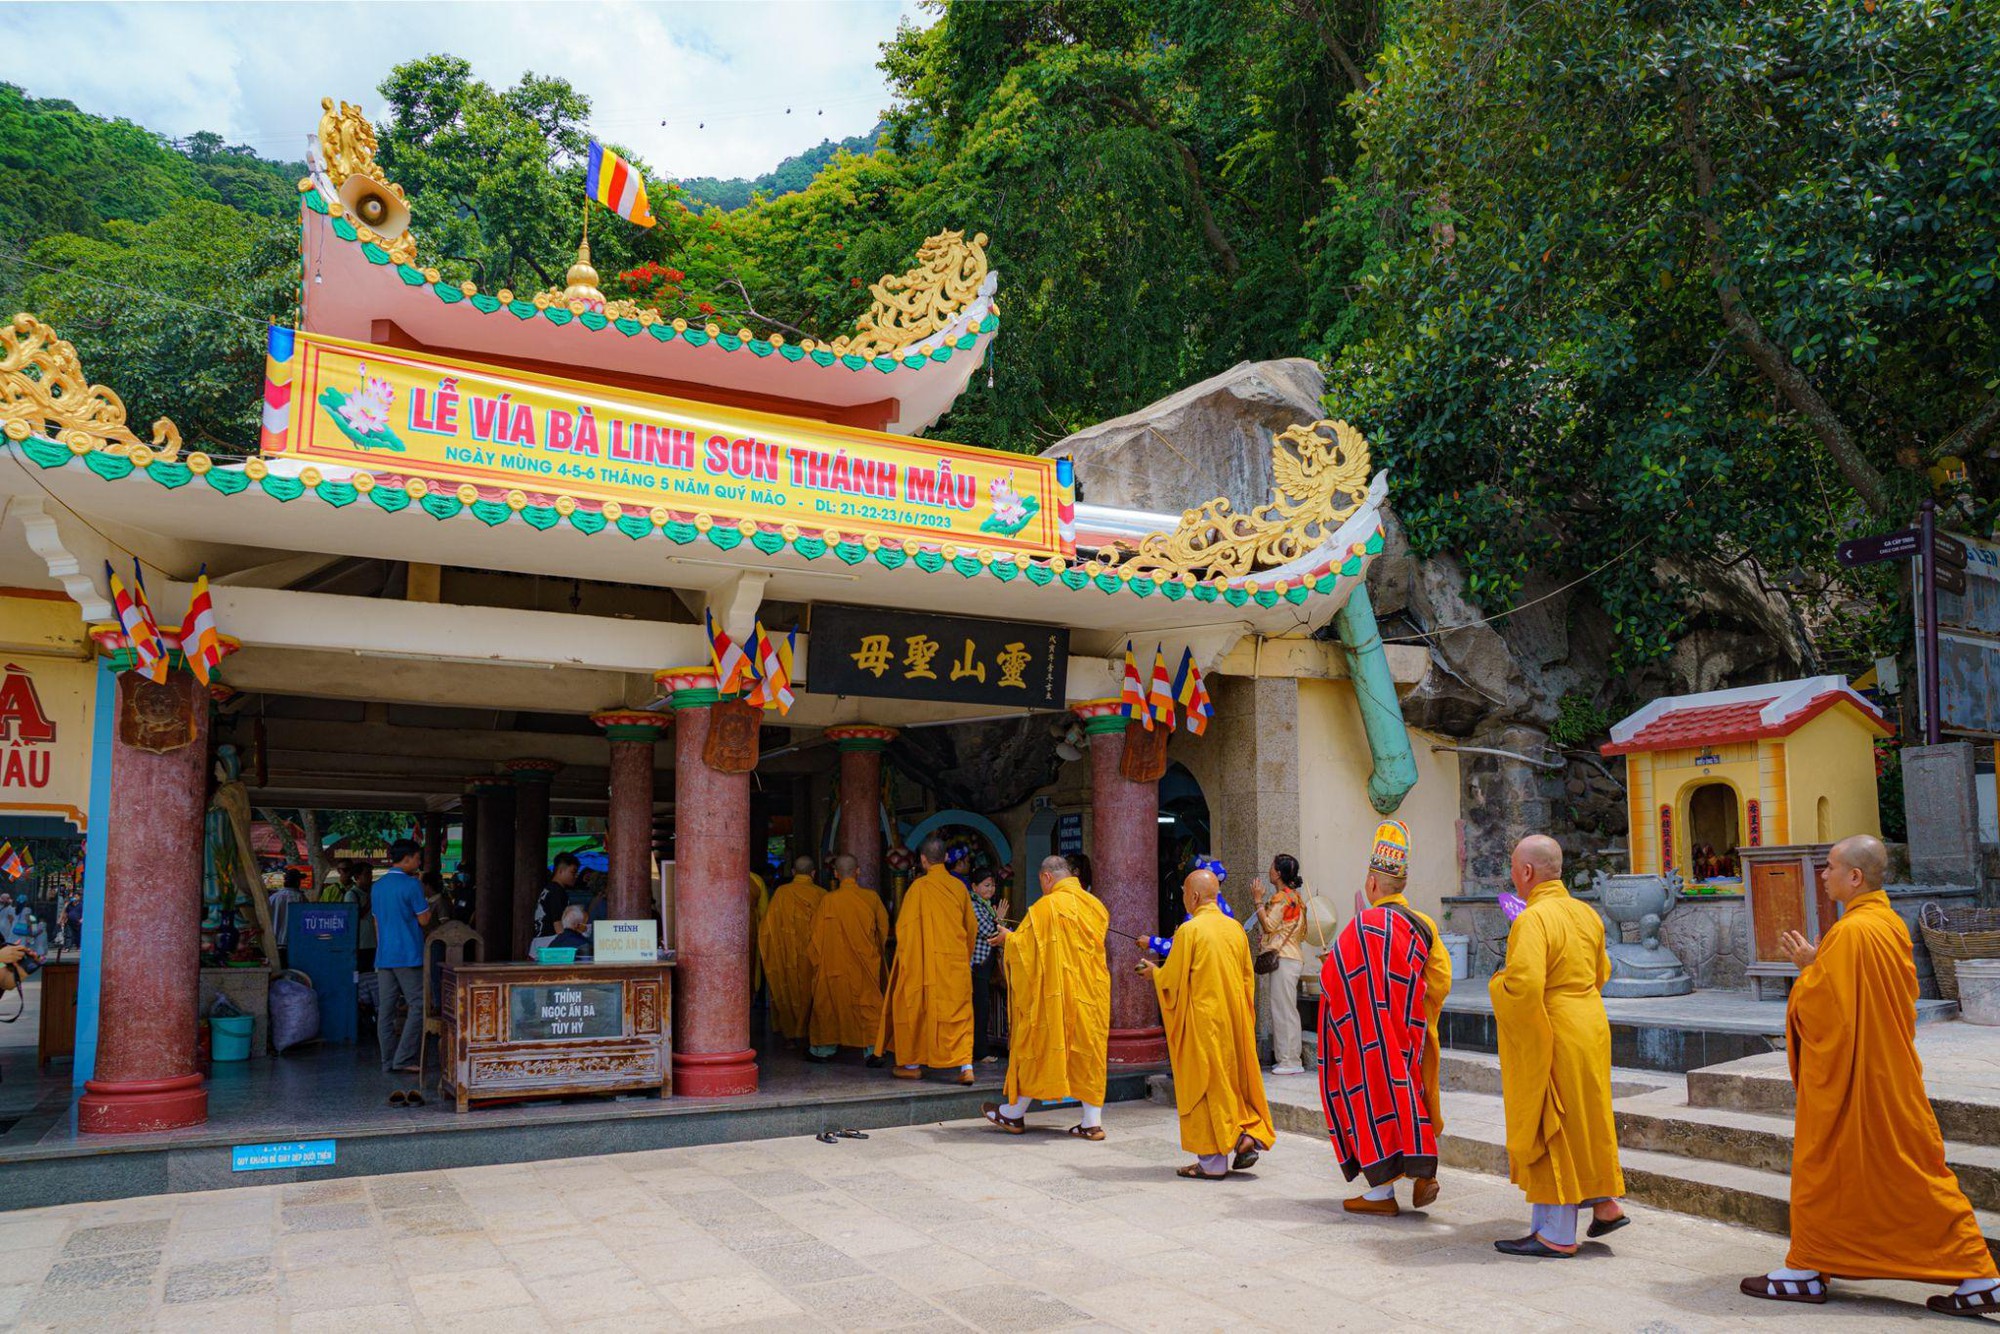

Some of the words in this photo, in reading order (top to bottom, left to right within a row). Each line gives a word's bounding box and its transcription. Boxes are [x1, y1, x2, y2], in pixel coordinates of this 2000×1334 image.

[408, 377, 460, 436] LỄ
[469, 393, 536, 448] VÍA
[545, 406, 600, 458] BÀ
[608, 419, 695, 472] LINH
[703, 434, 779, 484] SƠN
[786, 447, 898, 500] THÁNH
[904, 459, 977, 512] MẪU
[446, 446, 496, 466] NGÀY
[500, 453, 553, 474] MÙNG
[557, 463, 596, 481] 4-5-6
[600, 467, 656, 488] THÁNG
[660, 477, 670, 491] 5
[674, 477, 710, 497] NĂM
[714, 484, 747, 501] QUÝ
[751, 487, 787, 507] MÃO
[815, 499, 837, 514] DL:
[840, 502, 952, 528] 21-22-23/6/2023
[0, 739, 51, 788] ẪU
[319, 914, 345, 931] THIỆN
[554, 987, 582, 1003] THỈNH
[541, 1006, 567, 1020] NGỌC
[568, 1003, 581, 1017] ẤN
[551, 1020, 568, 1034] TÙY
[571, 1018, 584, 1034] HỶ
